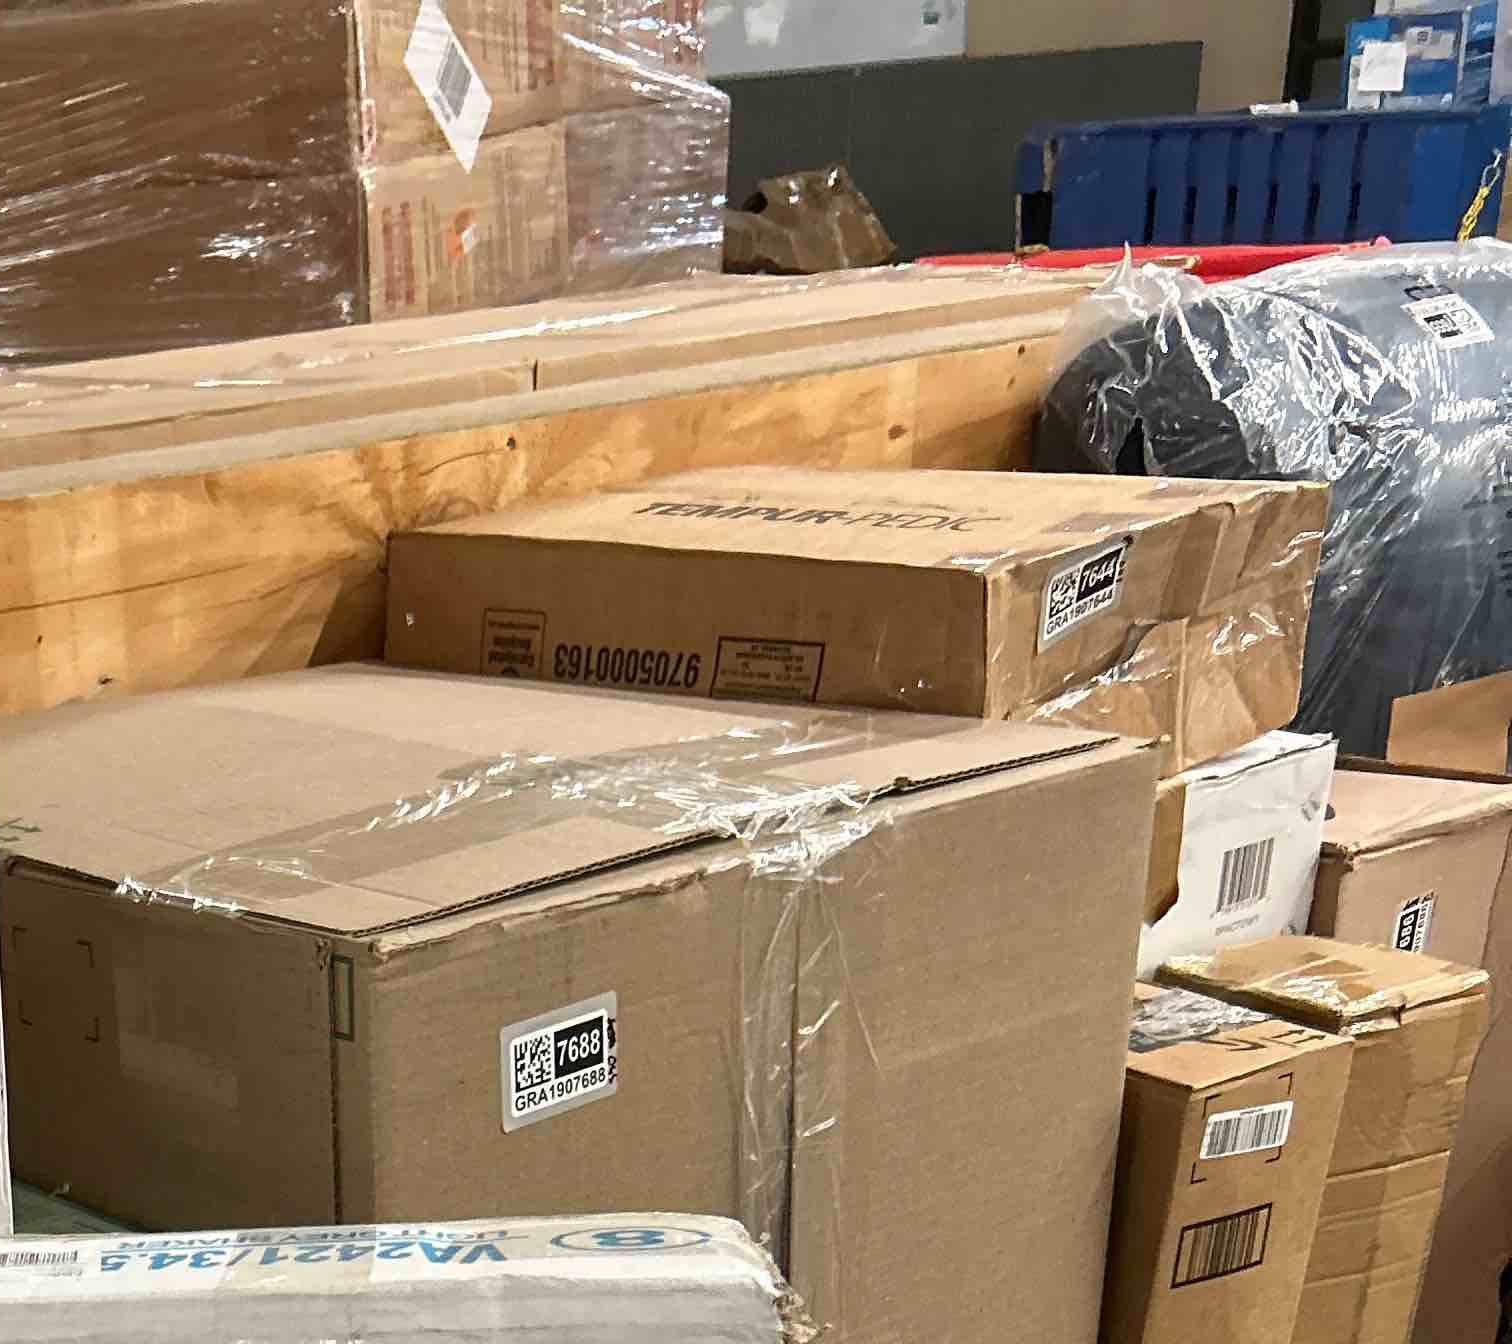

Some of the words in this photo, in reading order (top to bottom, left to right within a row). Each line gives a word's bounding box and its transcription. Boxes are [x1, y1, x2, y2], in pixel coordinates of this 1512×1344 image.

[633, 501, 1001, 533] TEMPUR-PEDIC
[1080, 556, 1118, 592] 7644
[552, 643, 702, 690] 9705000163
[556, 1029, 602, 1067] 7688
[514, 1067, 607, 1112] GRA1907688
[99, 1240, 508, 1273] VA2421/34.5
[592, 1230, 665, 1248] 8
